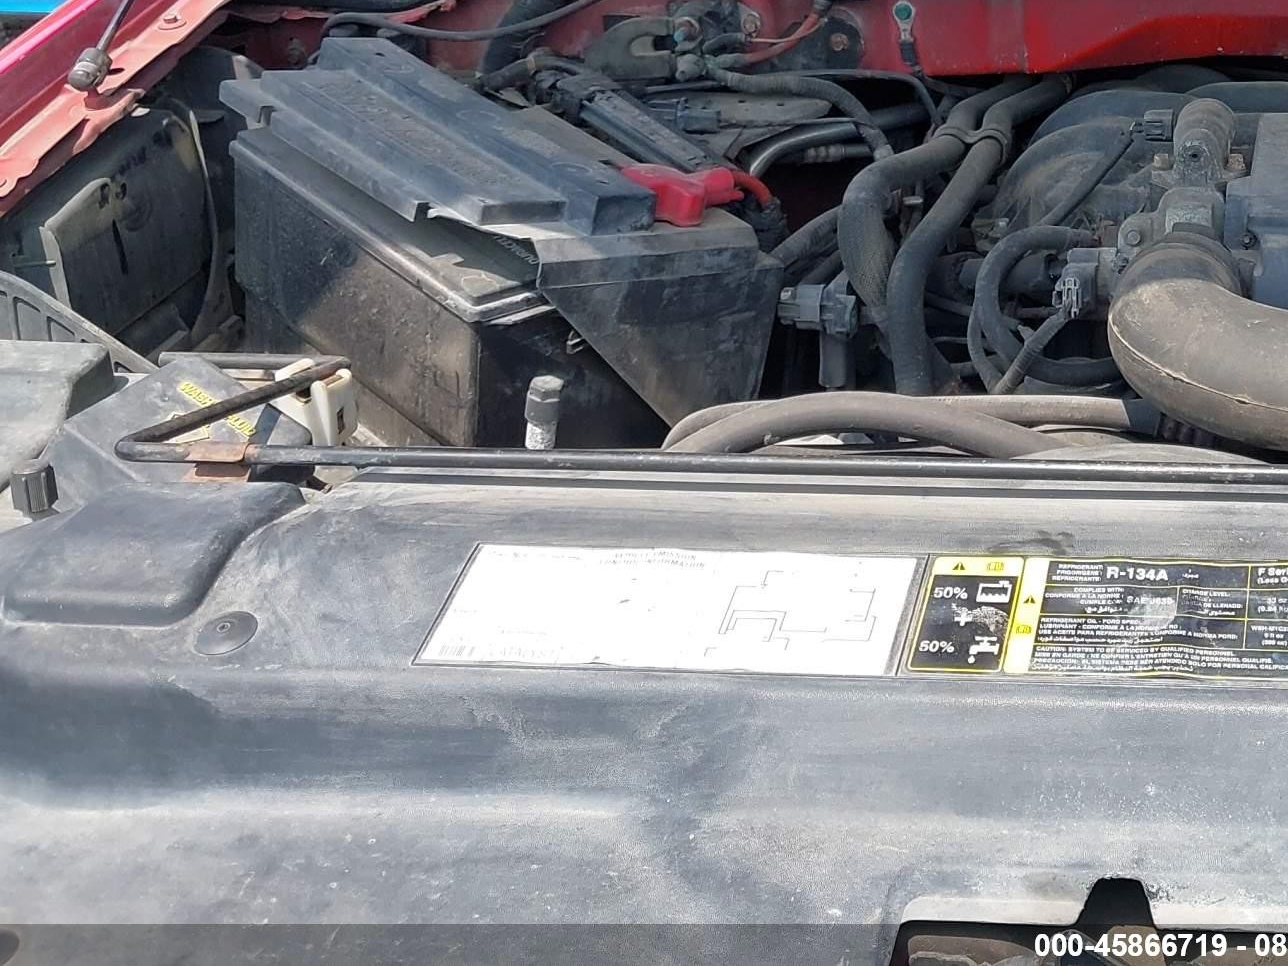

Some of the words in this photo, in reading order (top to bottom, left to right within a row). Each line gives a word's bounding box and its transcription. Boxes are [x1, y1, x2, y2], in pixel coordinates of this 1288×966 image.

[1106, 565, 1169, 581] R-134A
[1258, 567, 1265, 576] F
[933, 586, 968, 599] 50%
[919, 640, 955, 653] 50%
